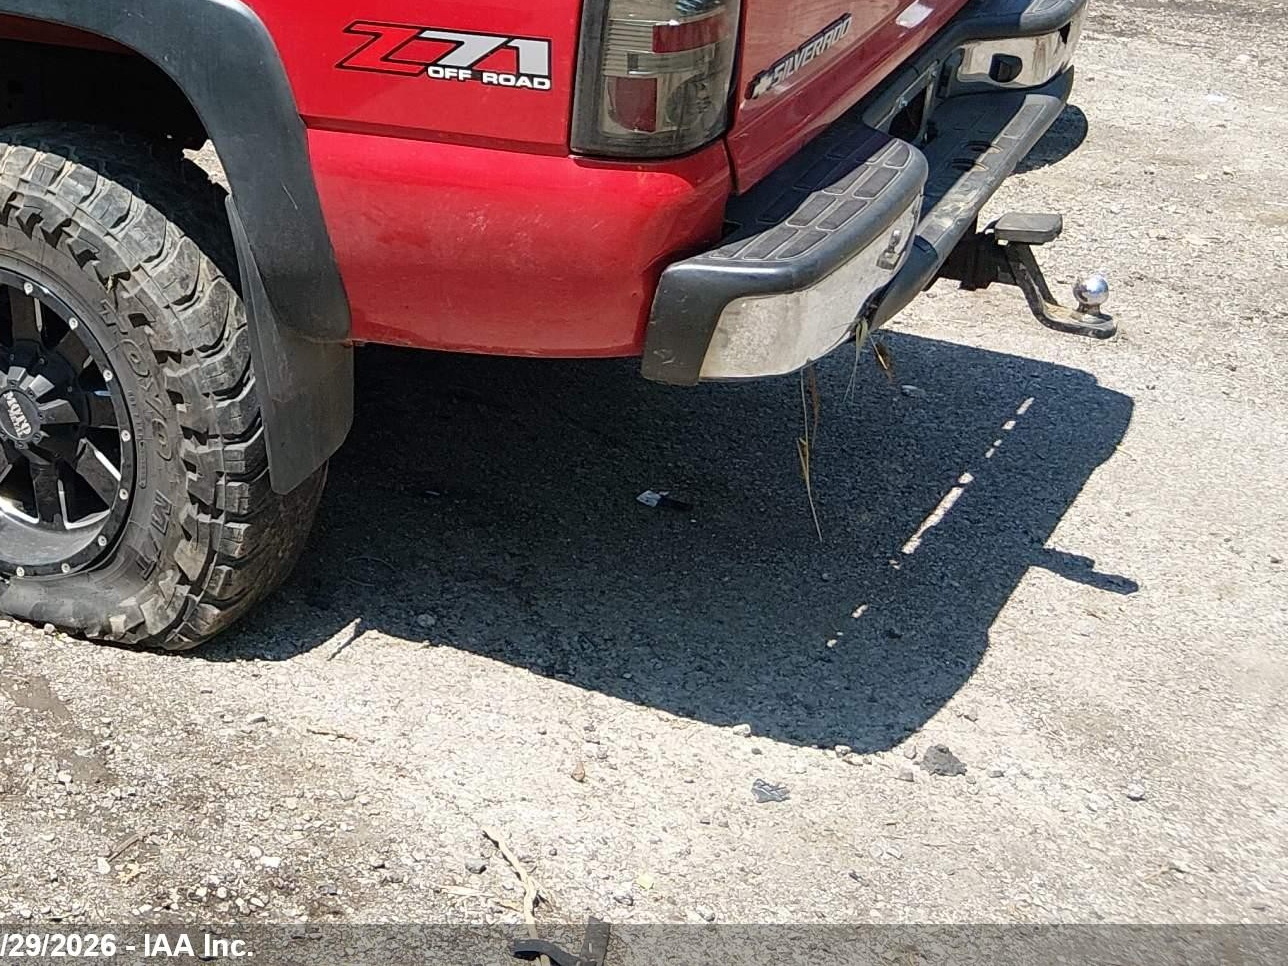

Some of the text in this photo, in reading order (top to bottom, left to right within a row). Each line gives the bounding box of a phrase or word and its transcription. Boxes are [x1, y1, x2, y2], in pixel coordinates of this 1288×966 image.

[334, 19, 553, 83] Z71
[426, 65, 552, 91] OFF ROAD
[770, 14, 853, 88] SILVERADO
[96, 297, 172, 463] TOYO
[2, 390, 32, 435] MOTO
